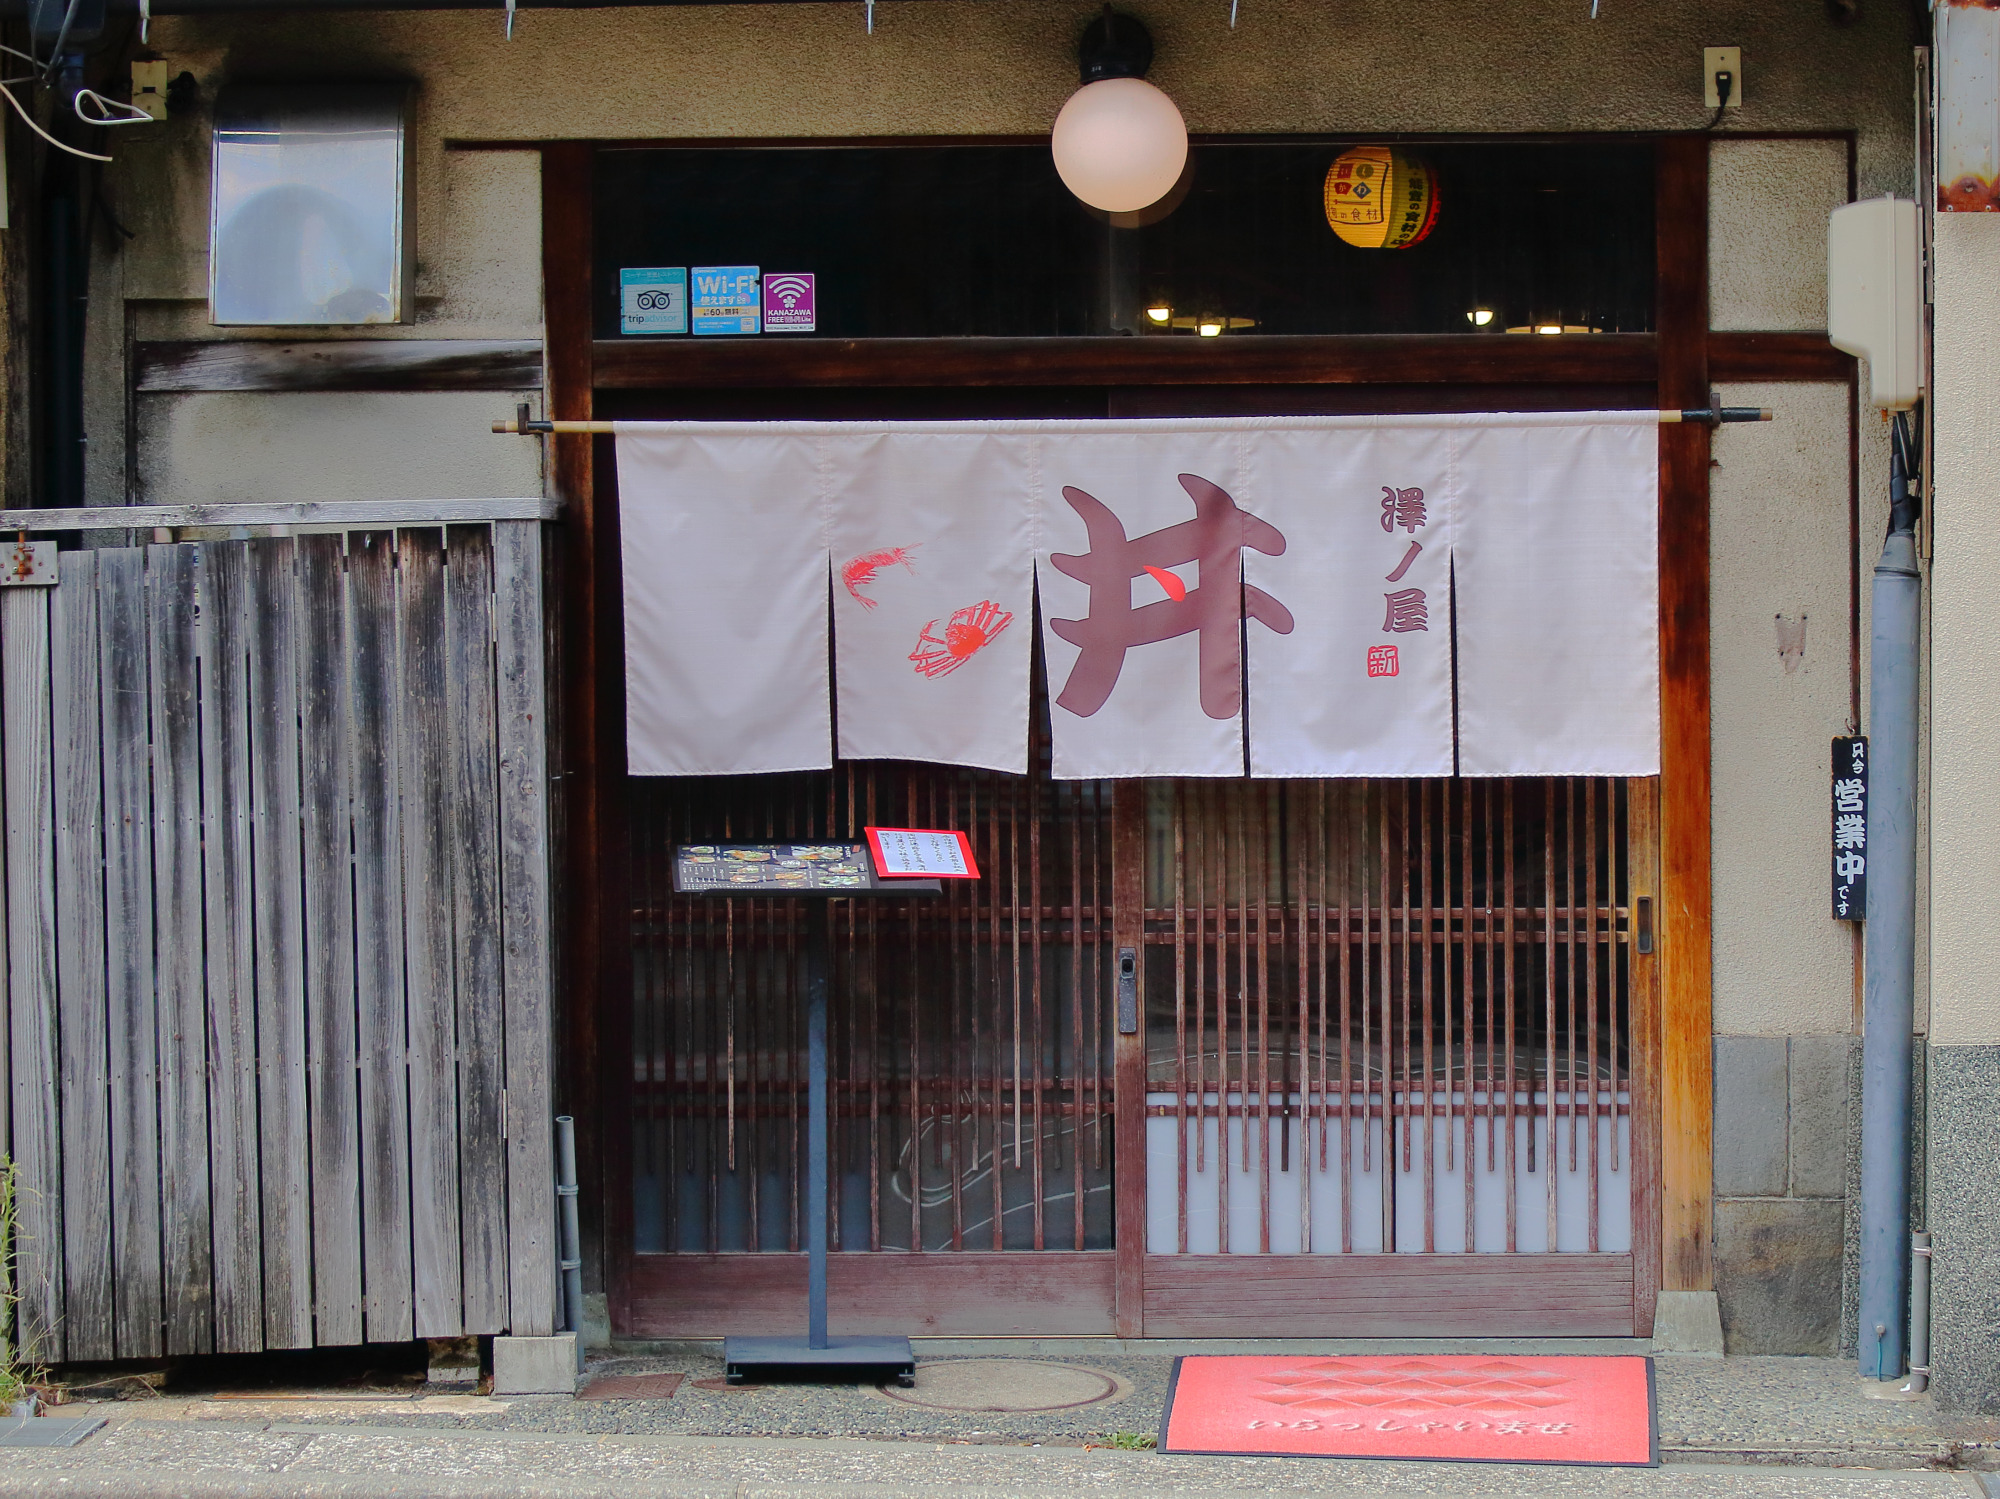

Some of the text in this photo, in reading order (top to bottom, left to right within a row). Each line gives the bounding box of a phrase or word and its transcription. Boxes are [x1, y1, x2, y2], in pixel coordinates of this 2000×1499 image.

[697, 275, 755, 294] Wi-Fi
[628, 314, 678, 324] tripadvisor
[1381, 486, 1428, 633] 澤ノ屋
[1247, 1418, 1574, 1435] いらっしゃいませ
